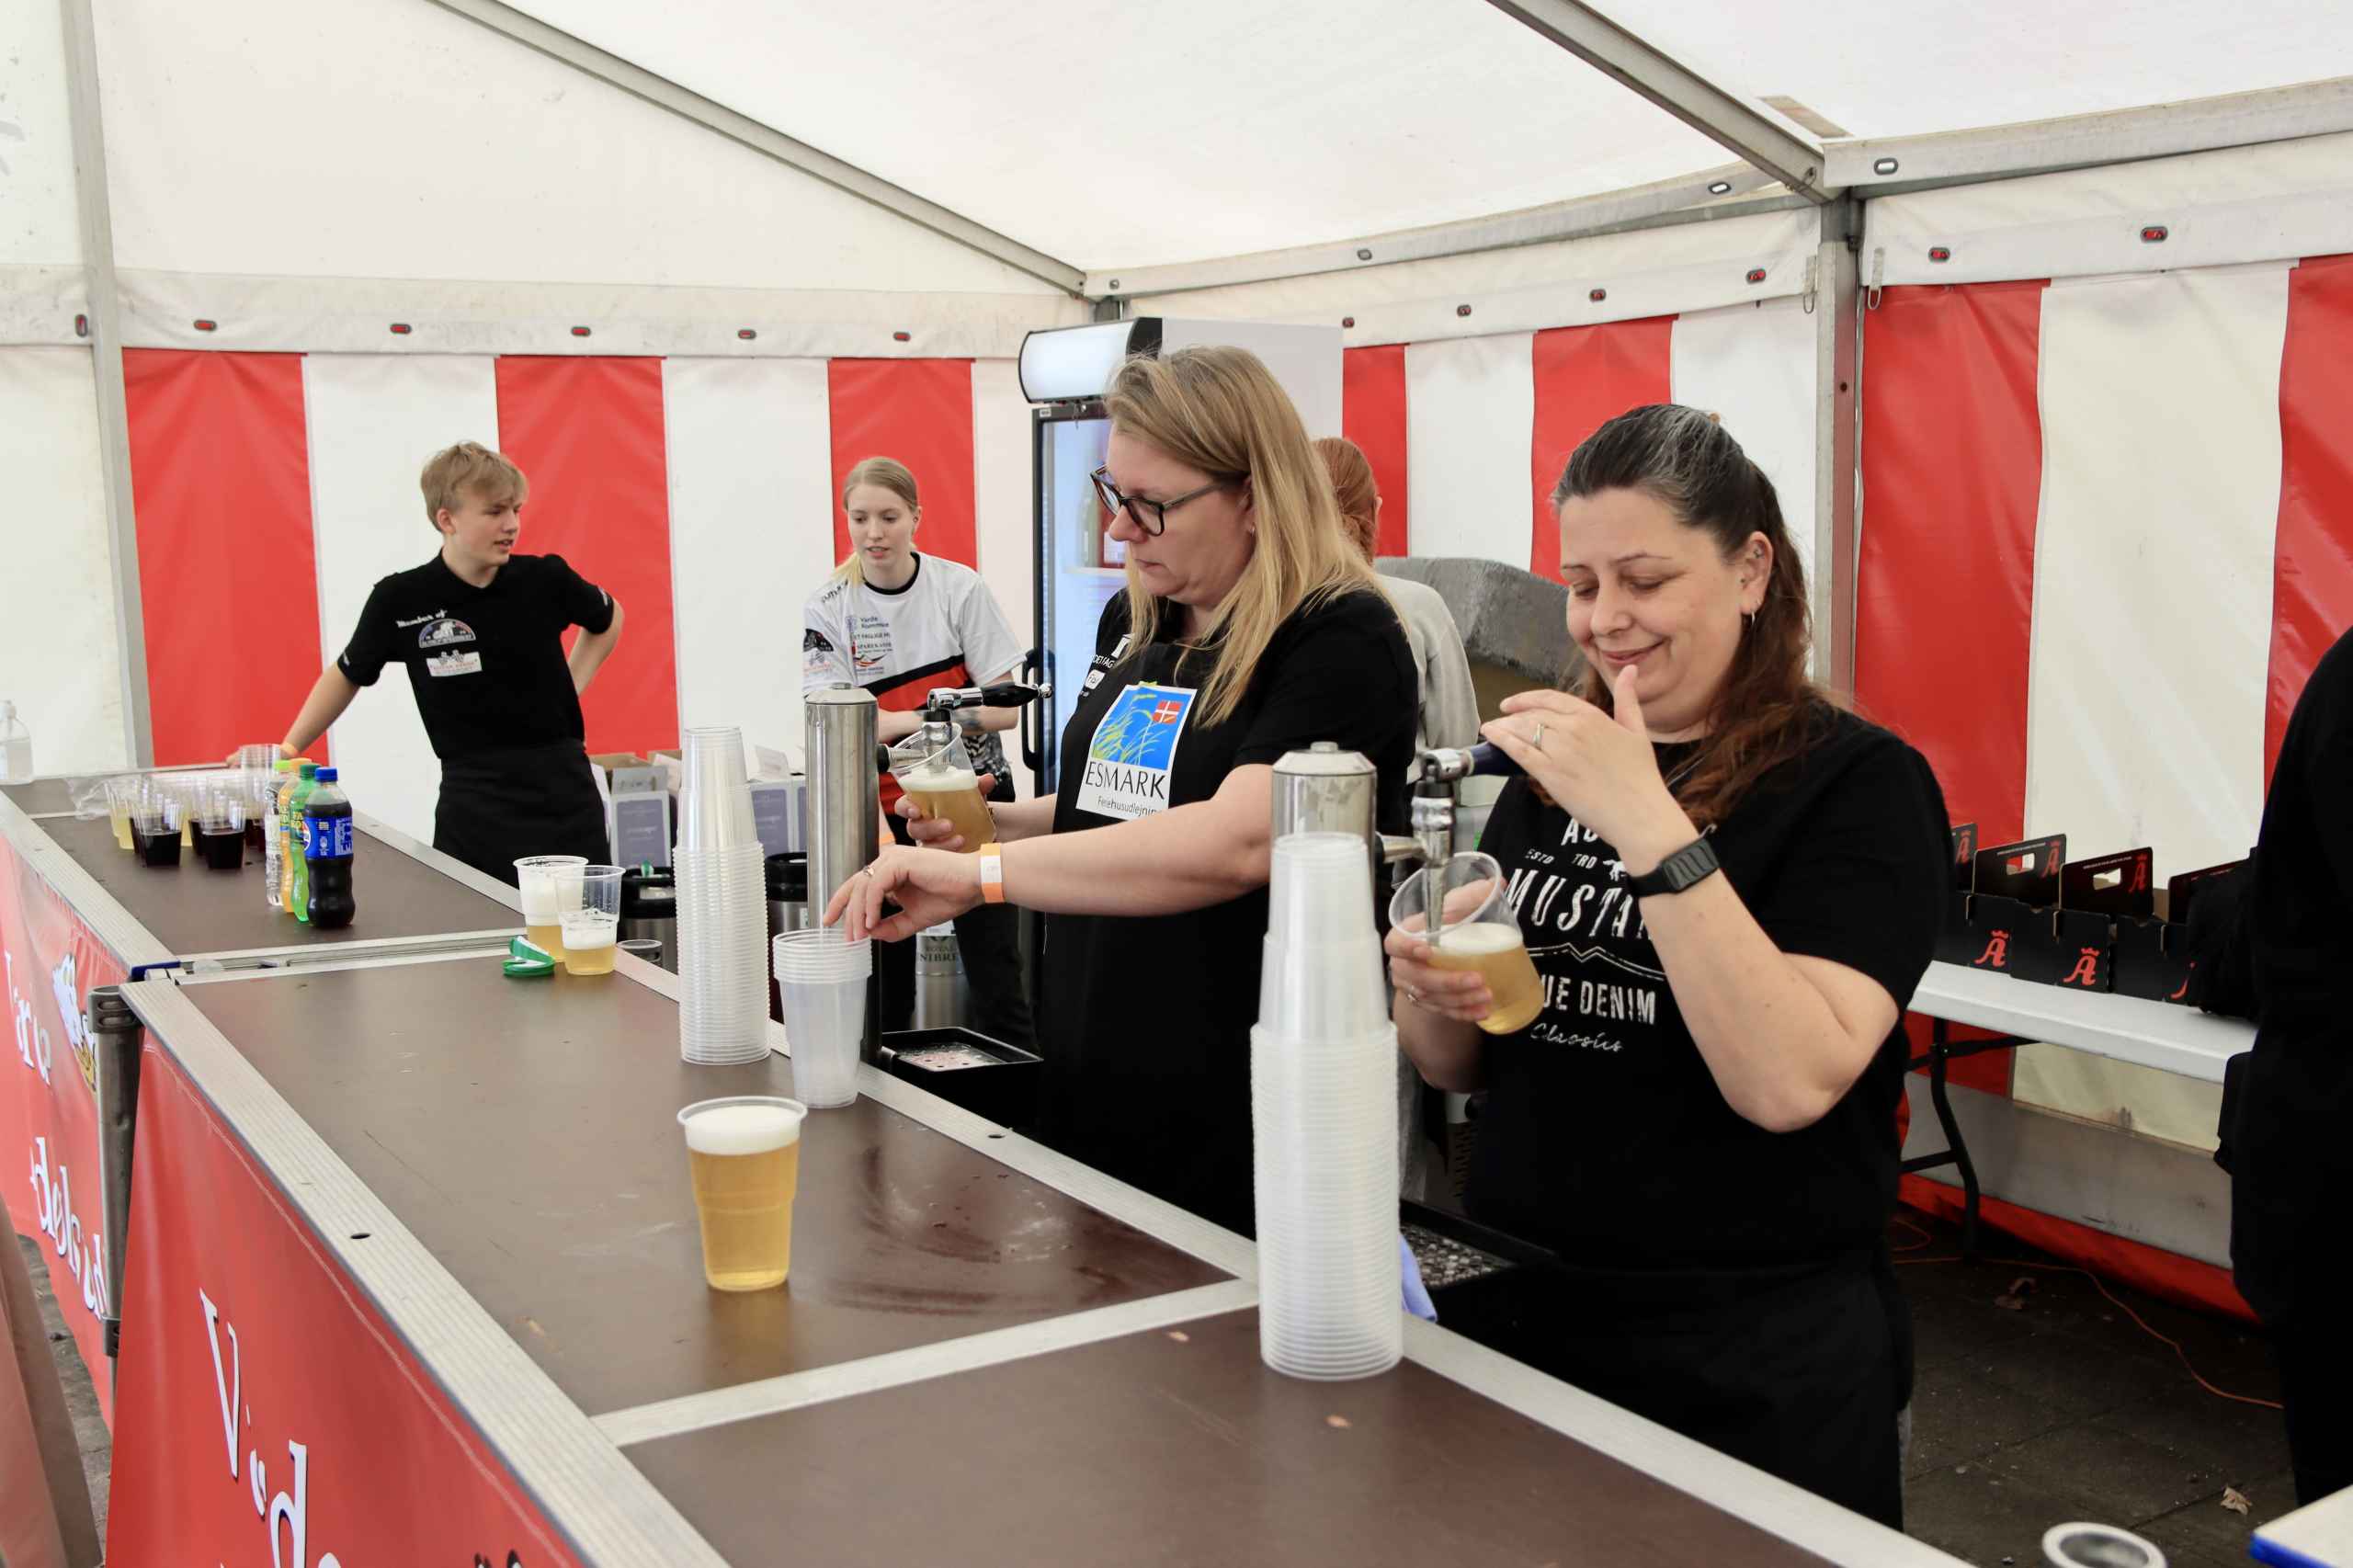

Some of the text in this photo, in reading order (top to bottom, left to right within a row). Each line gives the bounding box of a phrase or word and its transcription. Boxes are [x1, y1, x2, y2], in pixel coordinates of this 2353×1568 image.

[1086, 761, 1165, 800] ESMARK
[1505, 868, 1651, 940] MUSTA
[1541, 974, 1655, 1025] UE DENIM
